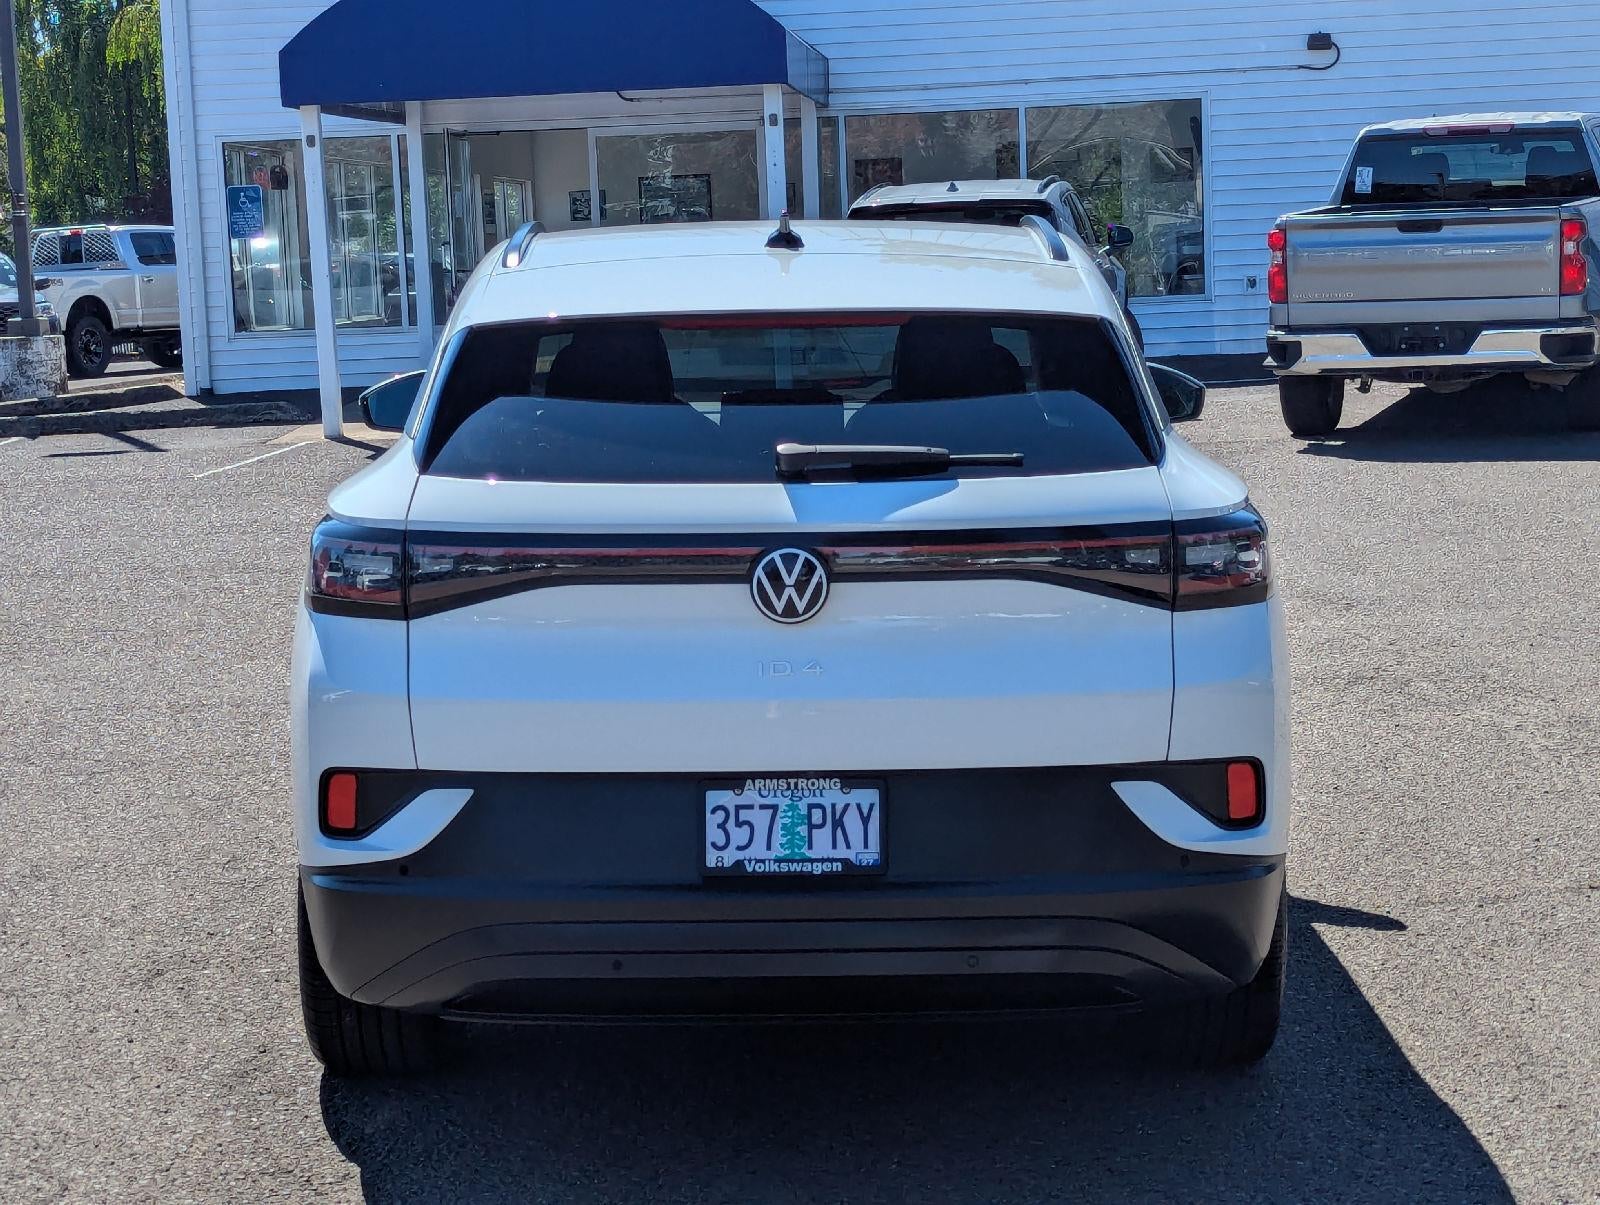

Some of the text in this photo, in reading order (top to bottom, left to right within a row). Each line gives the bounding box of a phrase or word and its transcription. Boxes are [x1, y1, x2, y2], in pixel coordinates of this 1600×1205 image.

[744, 778, 841, 790] ARMSTRONG
[710, 803, 875, 851] 357 PKY
[744, 860, 842, 874] Volkswagen
